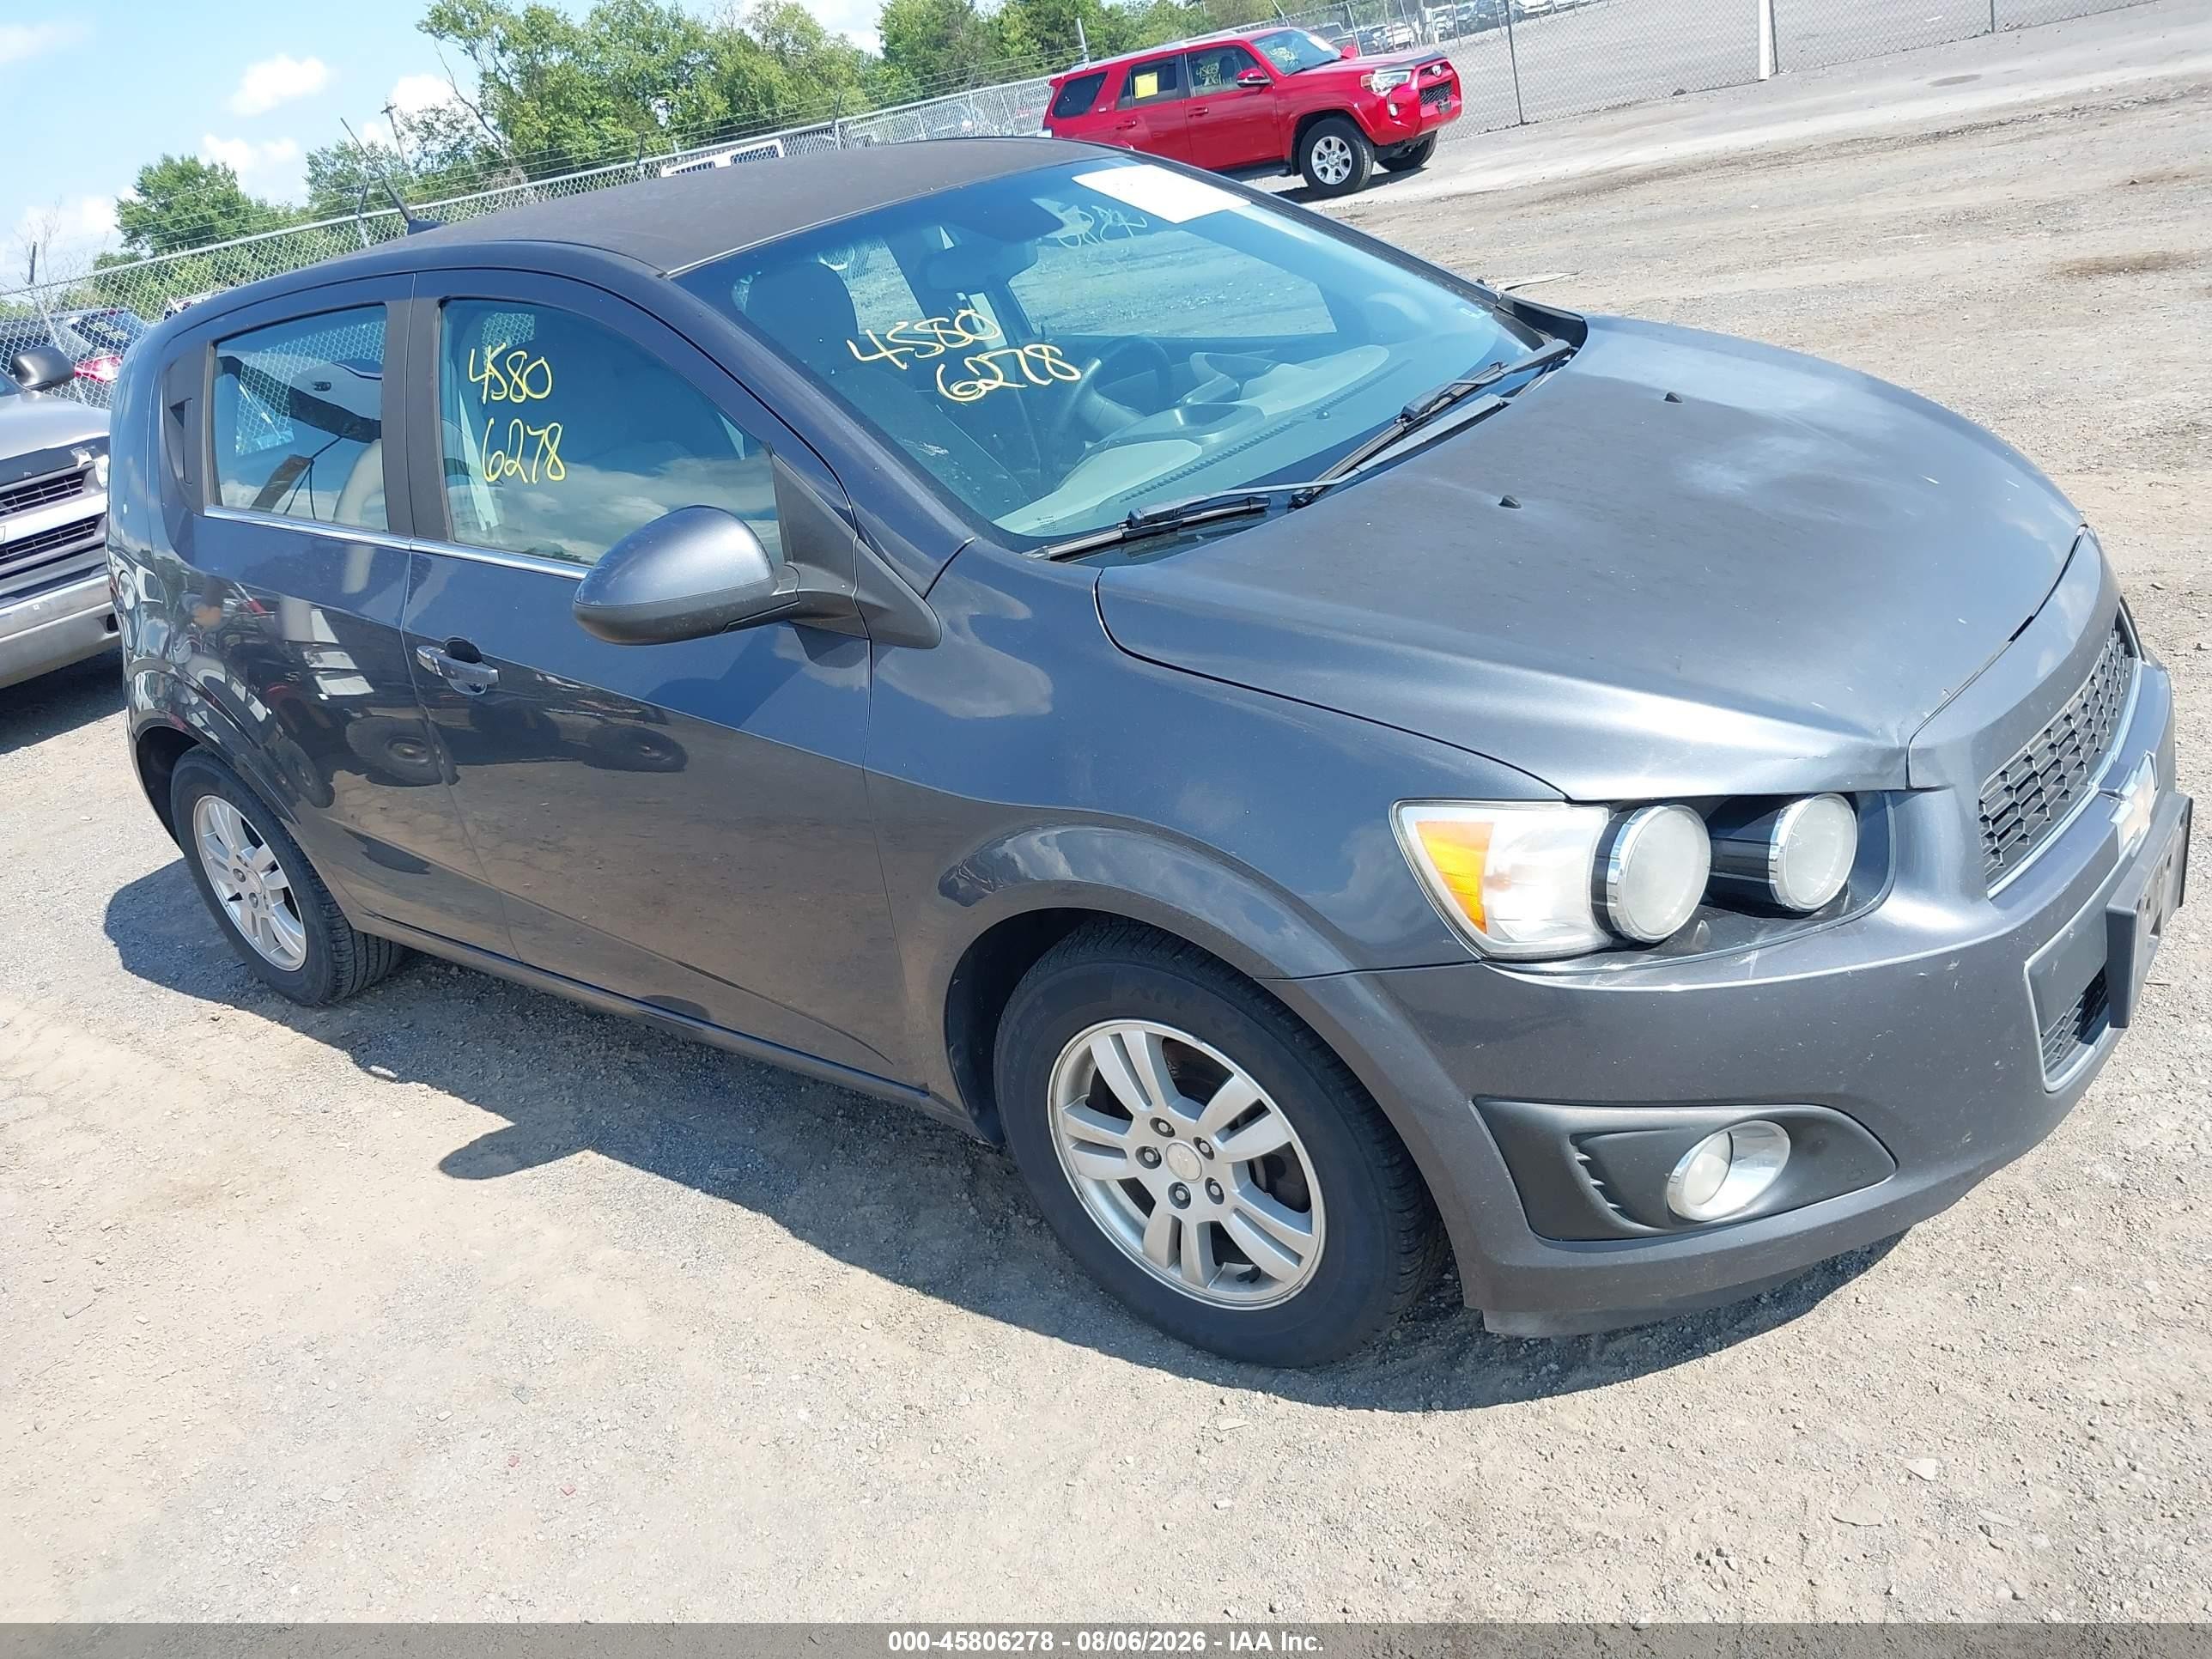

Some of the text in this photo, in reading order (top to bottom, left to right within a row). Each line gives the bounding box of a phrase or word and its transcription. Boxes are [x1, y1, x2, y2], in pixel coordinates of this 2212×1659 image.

[846, 309, 1002, 370] 4580
[468, 342, 553, 405] 4580
[936, 343, 1082, 402] 6278
[482, 417, 567, 484] 6278
